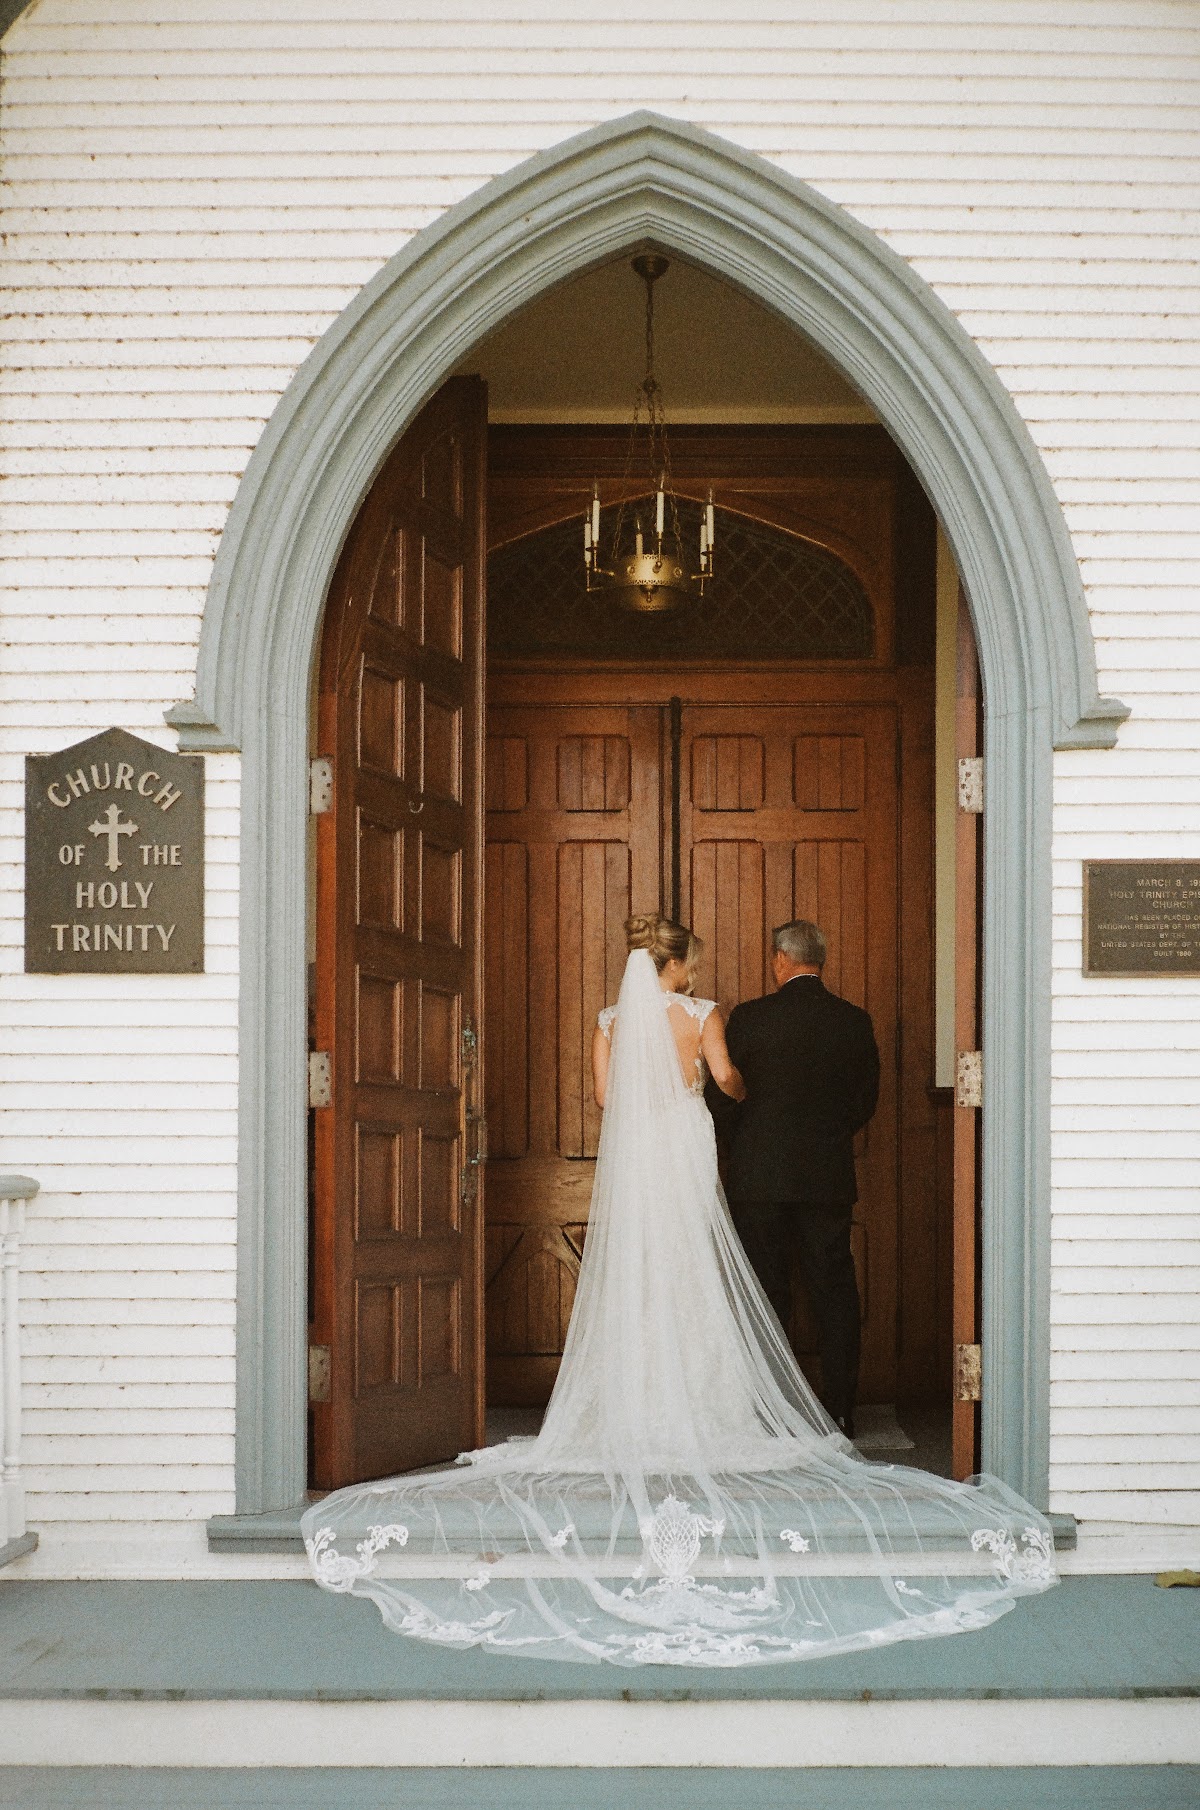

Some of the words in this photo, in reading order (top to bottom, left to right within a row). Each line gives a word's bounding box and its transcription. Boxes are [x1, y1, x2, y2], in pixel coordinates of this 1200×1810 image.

[47, 762, 182, 811] CHURCH
[58, 844, 86, 866] OF
[138, 844, 183, 866] THE
[1136, 879, 1171, 887] MARCH
[1189, 879, 1200, 887] 19
[76, 881, 154, 909] HOLY
[1109, 891, 1135, 899] HOLY
[1140, 891, 1178, 899] TRINITY
[1152, 900, 1193, 909] CHURCH
[51, 923, 177, 952] TRINITY
